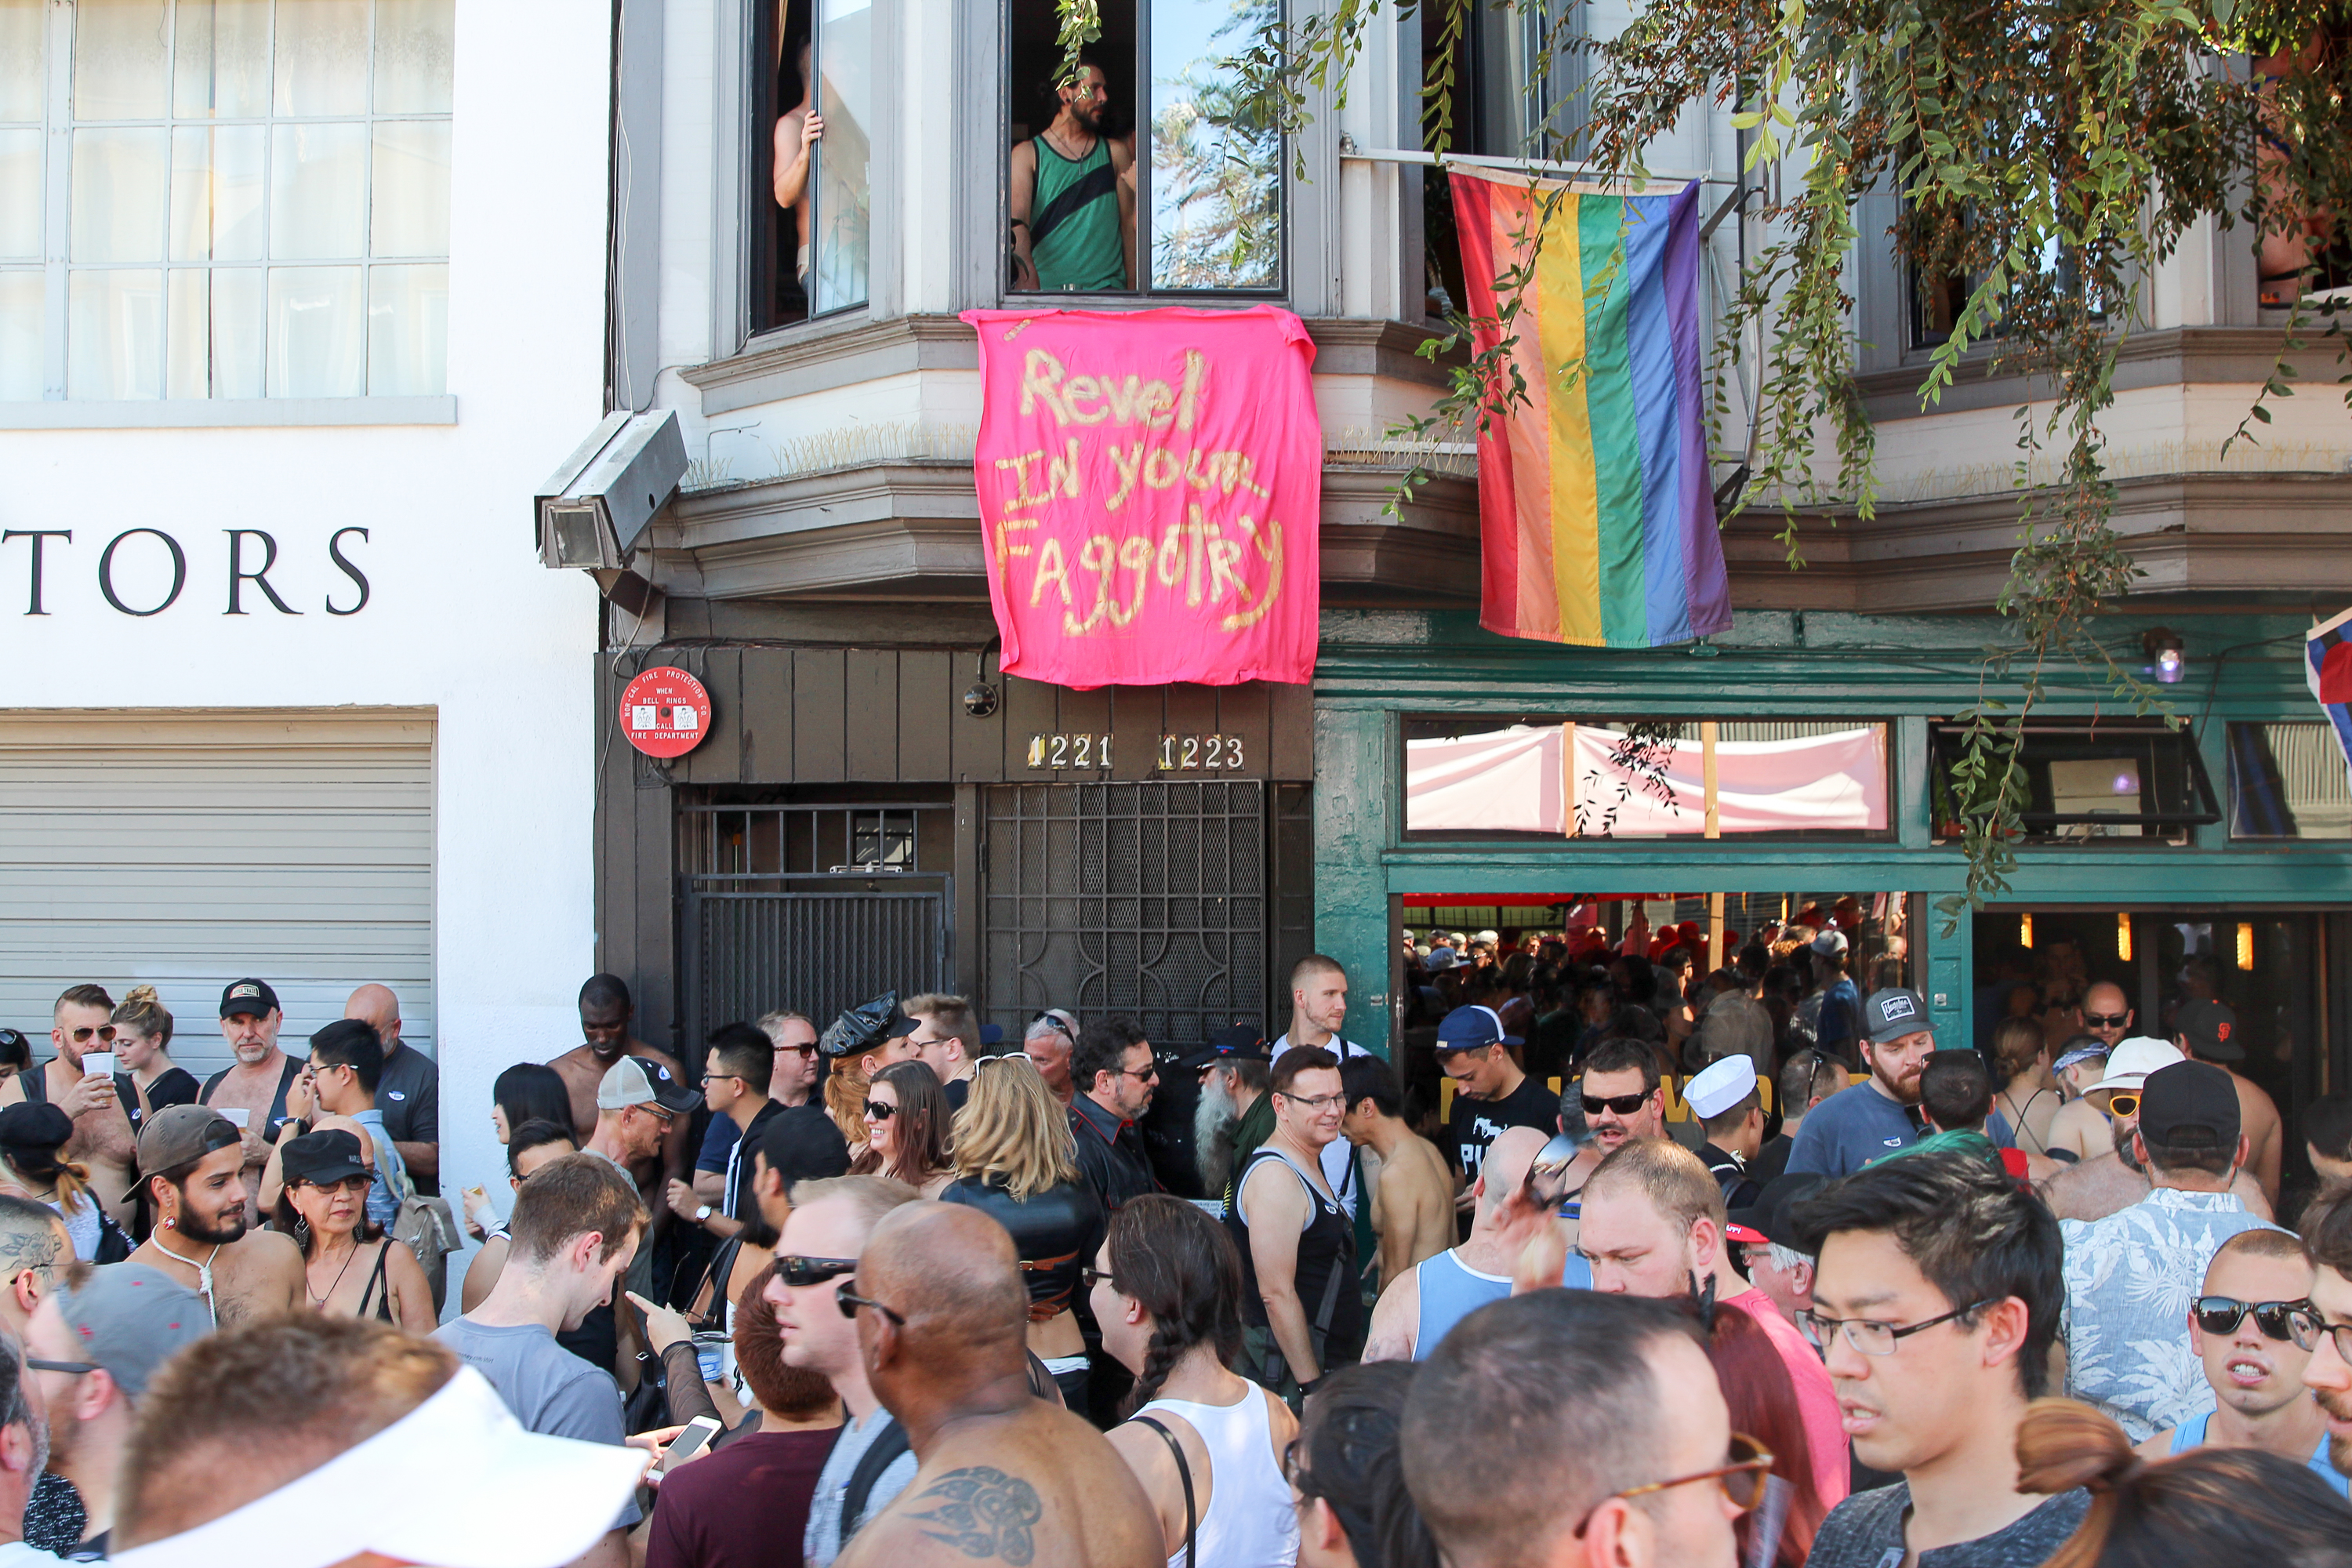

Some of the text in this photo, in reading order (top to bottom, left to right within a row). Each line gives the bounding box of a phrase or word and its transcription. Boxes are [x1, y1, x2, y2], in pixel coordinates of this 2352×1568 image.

[1020, 348, 1206, 431] Revel
[2, 527, 370, 616] TORS
[624, 685, 640, 717] NOR-CAL
[642, 672, 659, 684] FIRE
[666, 670, 703, 699] PROTECTION
[1030, 735, 1244, 768] 1221 1223
